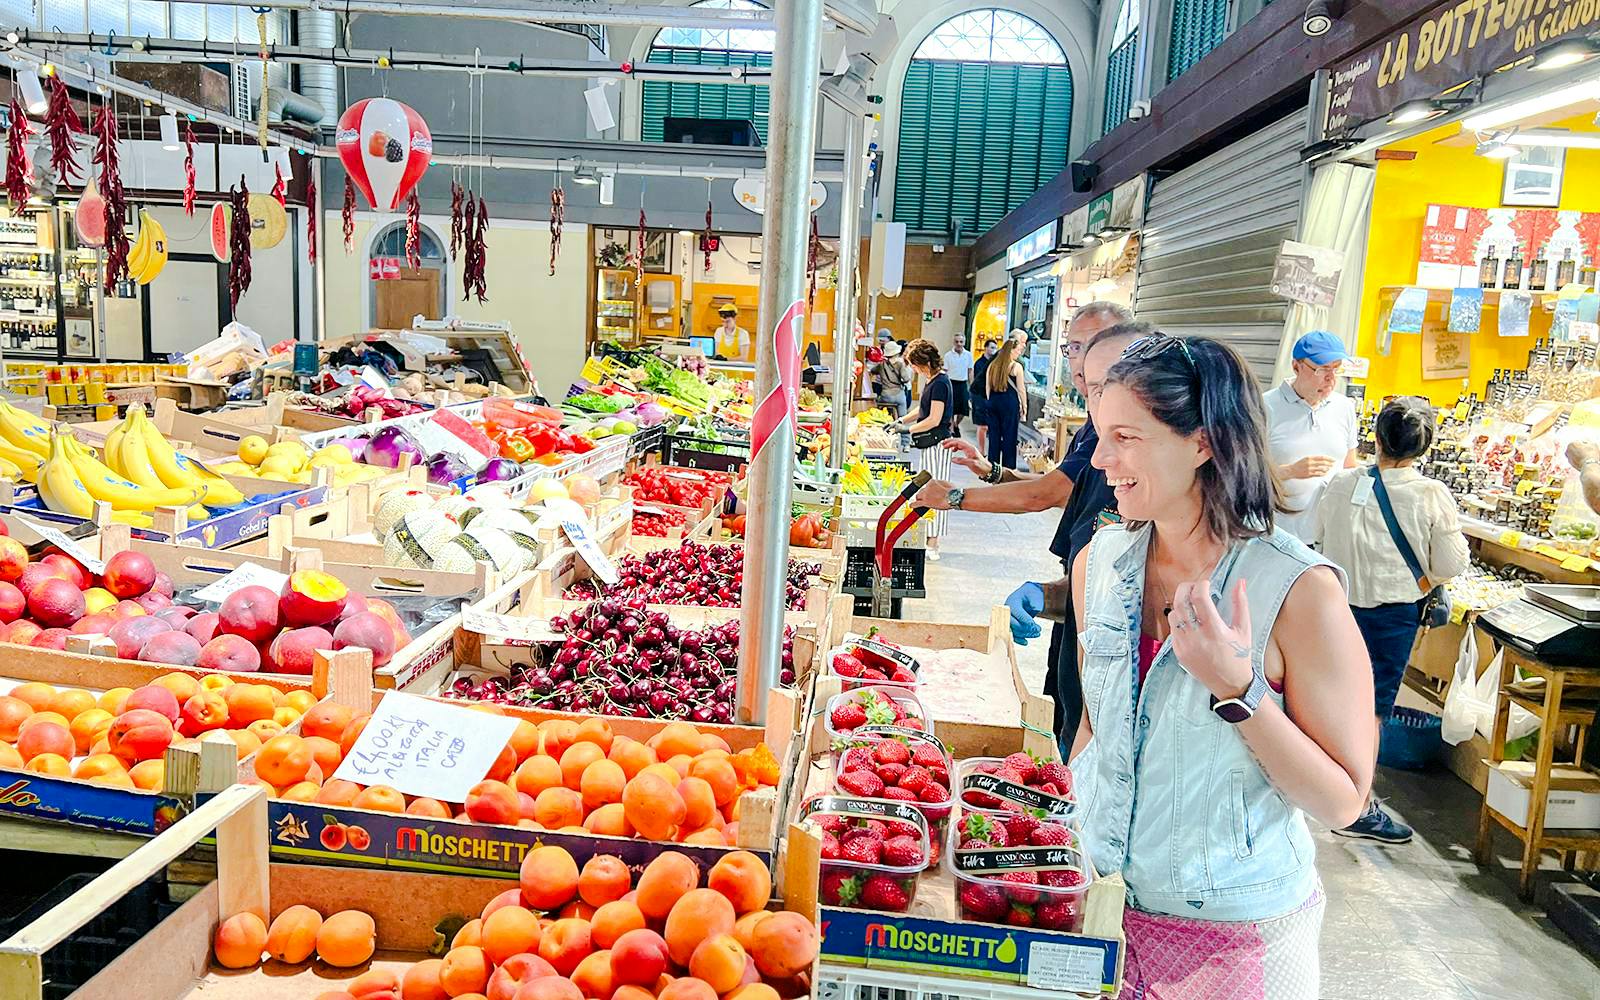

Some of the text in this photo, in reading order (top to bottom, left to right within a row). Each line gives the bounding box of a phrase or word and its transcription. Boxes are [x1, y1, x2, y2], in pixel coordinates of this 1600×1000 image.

[1514, 20, 1535, 53] DA
[1377, 33, 1409, 88] LA
[239, 521, 260, 537] Gebel
[416, 729, 448, 767] ITALIA
[995, 852, 1036, 862] CANDONGA
